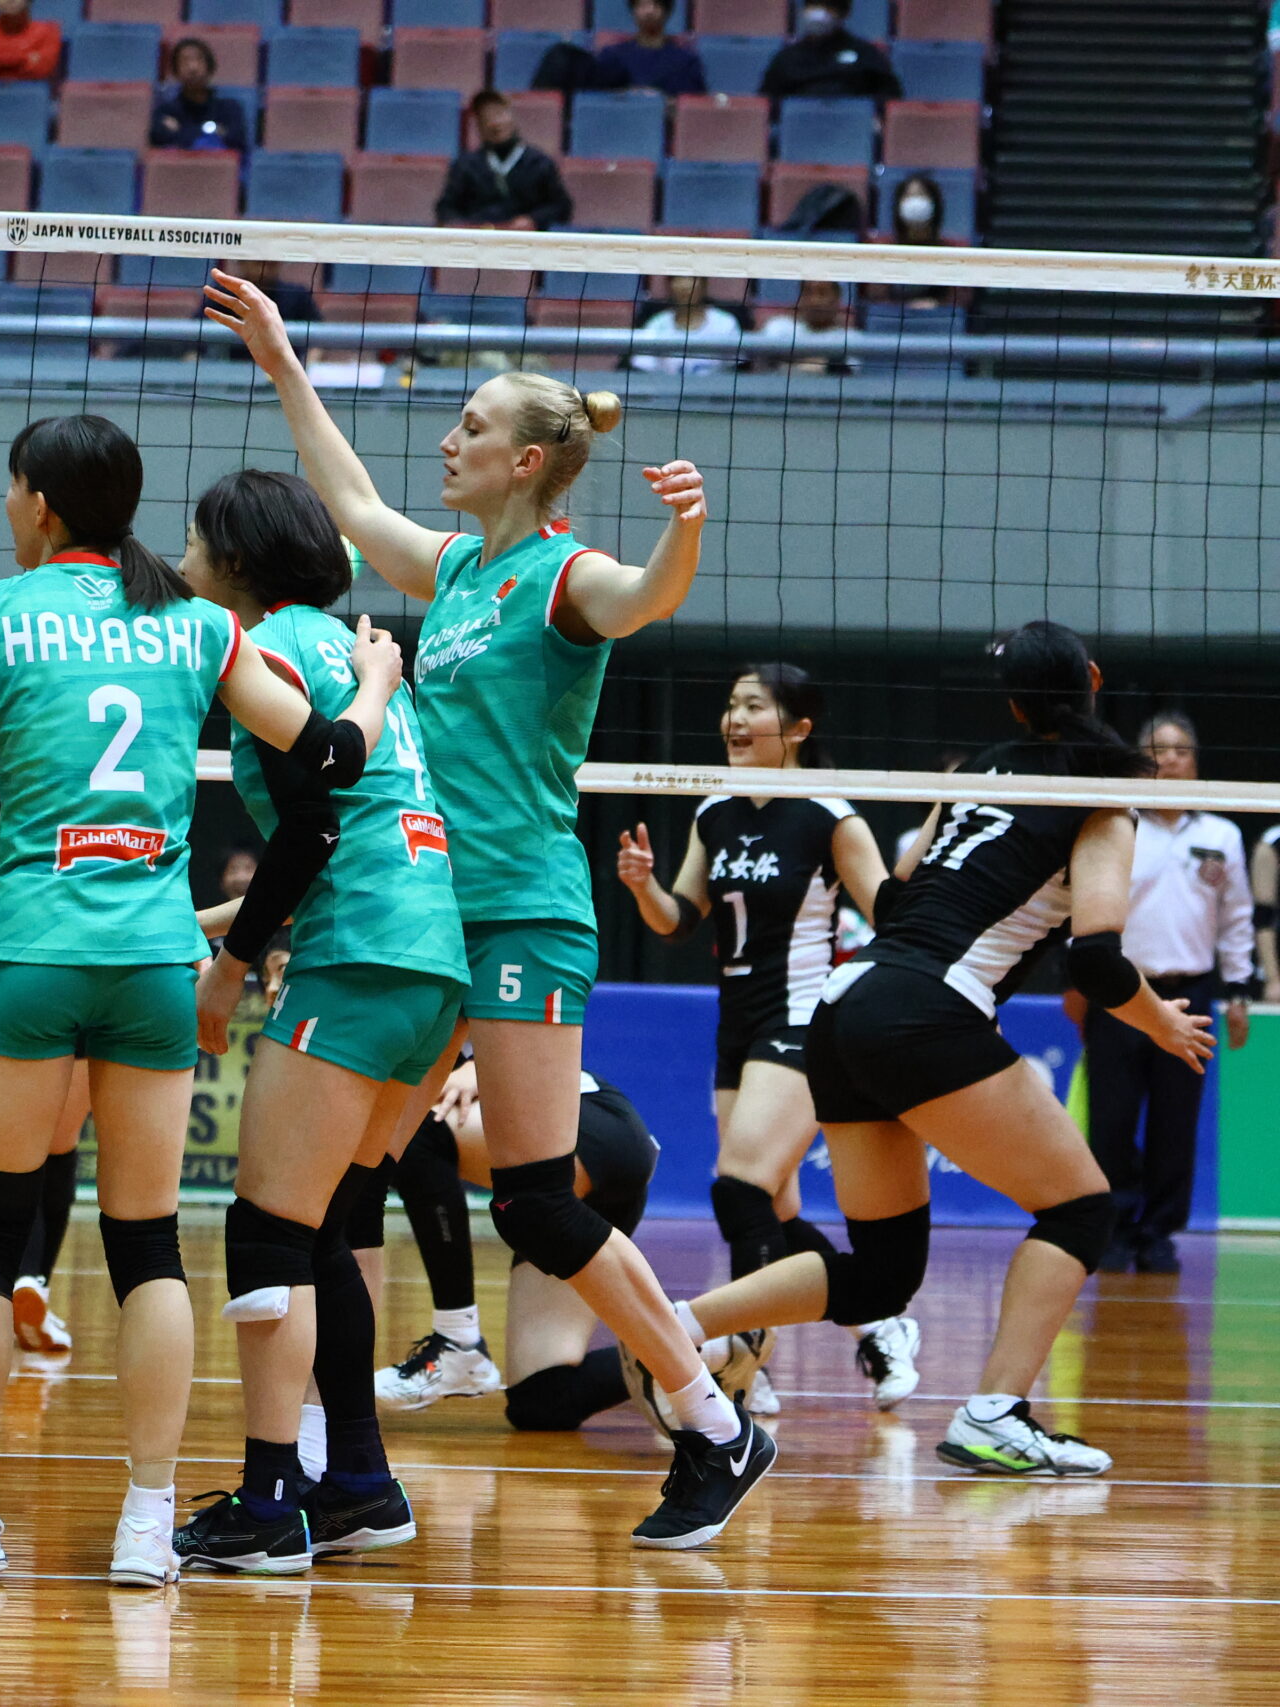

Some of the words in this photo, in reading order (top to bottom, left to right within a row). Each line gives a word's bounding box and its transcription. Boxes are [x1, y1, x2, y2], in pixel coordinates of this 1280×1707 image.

[32, 223, 74, 239] JAPAN
[78, 225, 155, 243] VOLLEYBALL
[158, 229, 243, 247] ASSOCIATION
[1, 611, 203, 672] HAYASHI
[88, 684, 145, 793] 2
[64, 830, 161, 852] TableMark
[722, 891, 749, 960] 1
[498, 964, 523, 1002] 5
